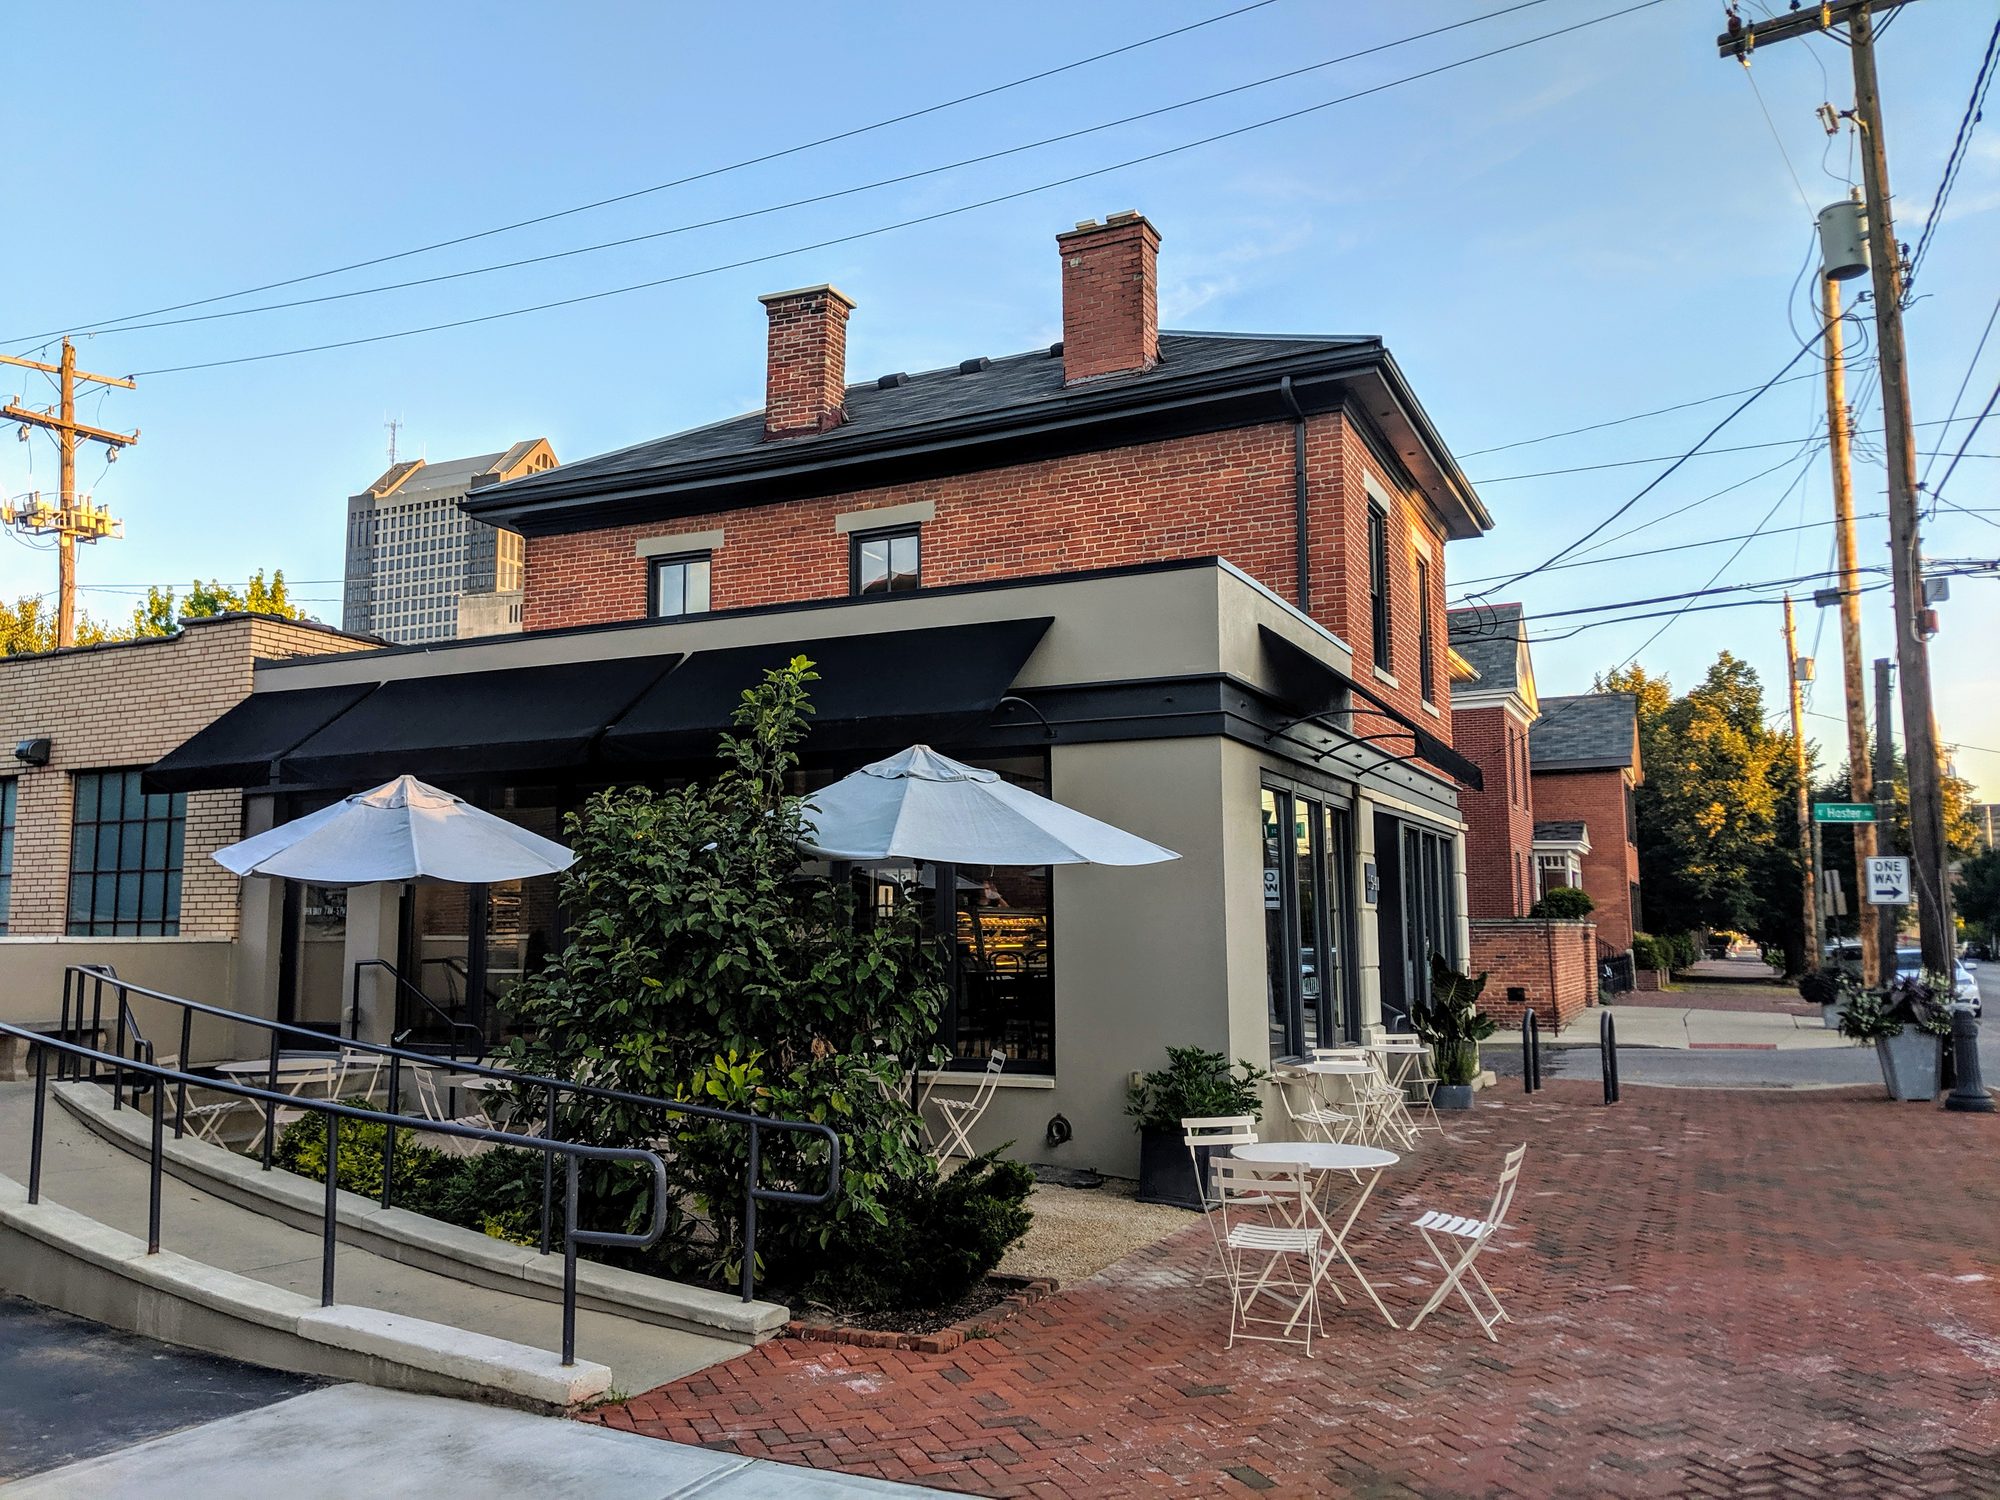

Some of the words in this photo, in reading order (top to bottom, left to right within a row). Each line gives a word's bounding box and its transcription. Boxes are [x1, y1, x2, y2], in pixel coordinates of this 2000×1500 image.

[1827, 808, 1862, 819] Hoster
[1875, 861, 1902, 872] ONE
[1874, 873, 1903, 884] WAY
